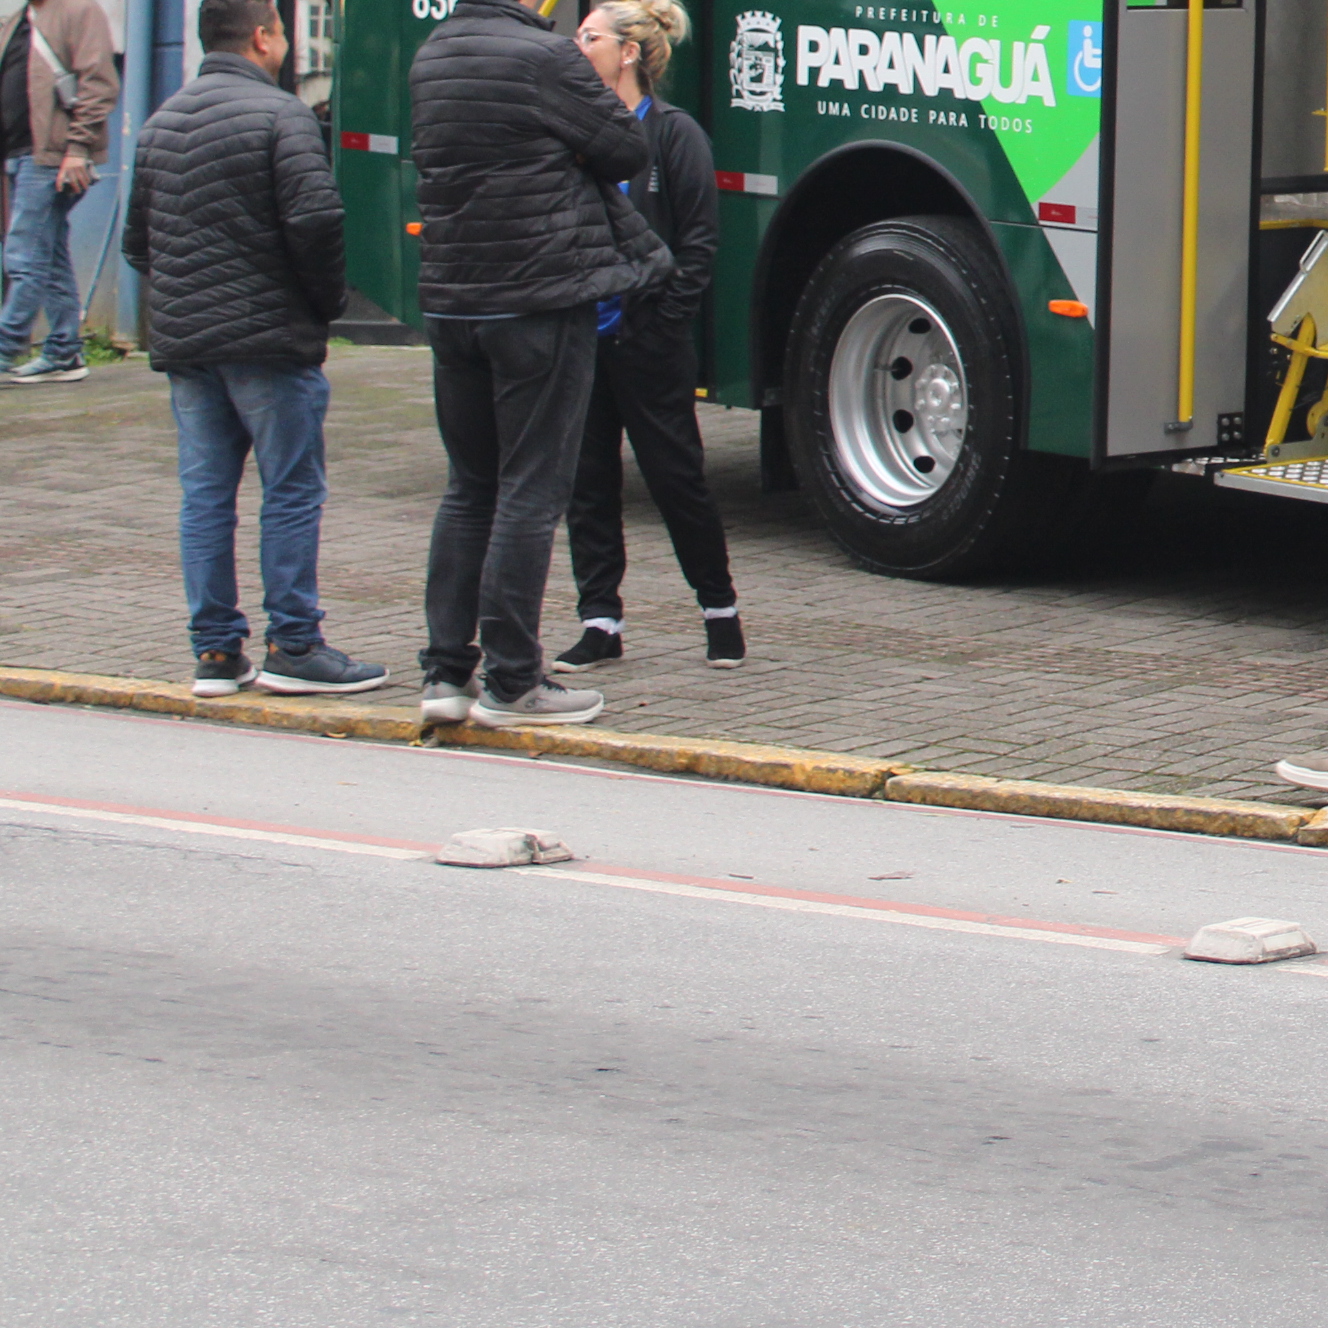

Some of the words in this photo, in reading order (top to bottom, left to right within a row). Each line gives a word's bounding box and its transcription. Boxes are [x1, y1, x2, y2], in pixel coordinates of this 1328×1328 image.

[855, 5, 967, 26] PREFEITURA
[980, 14, 999, 27] DE
[797, 24, 1056, 108] PARANAGUÁ
[818, 100, 850, 118] UMA
[862, 104, 918, 124] CIDADE
[928, 110, 970, 128] PARA
[978, 113, 1034, 134] TODOS
